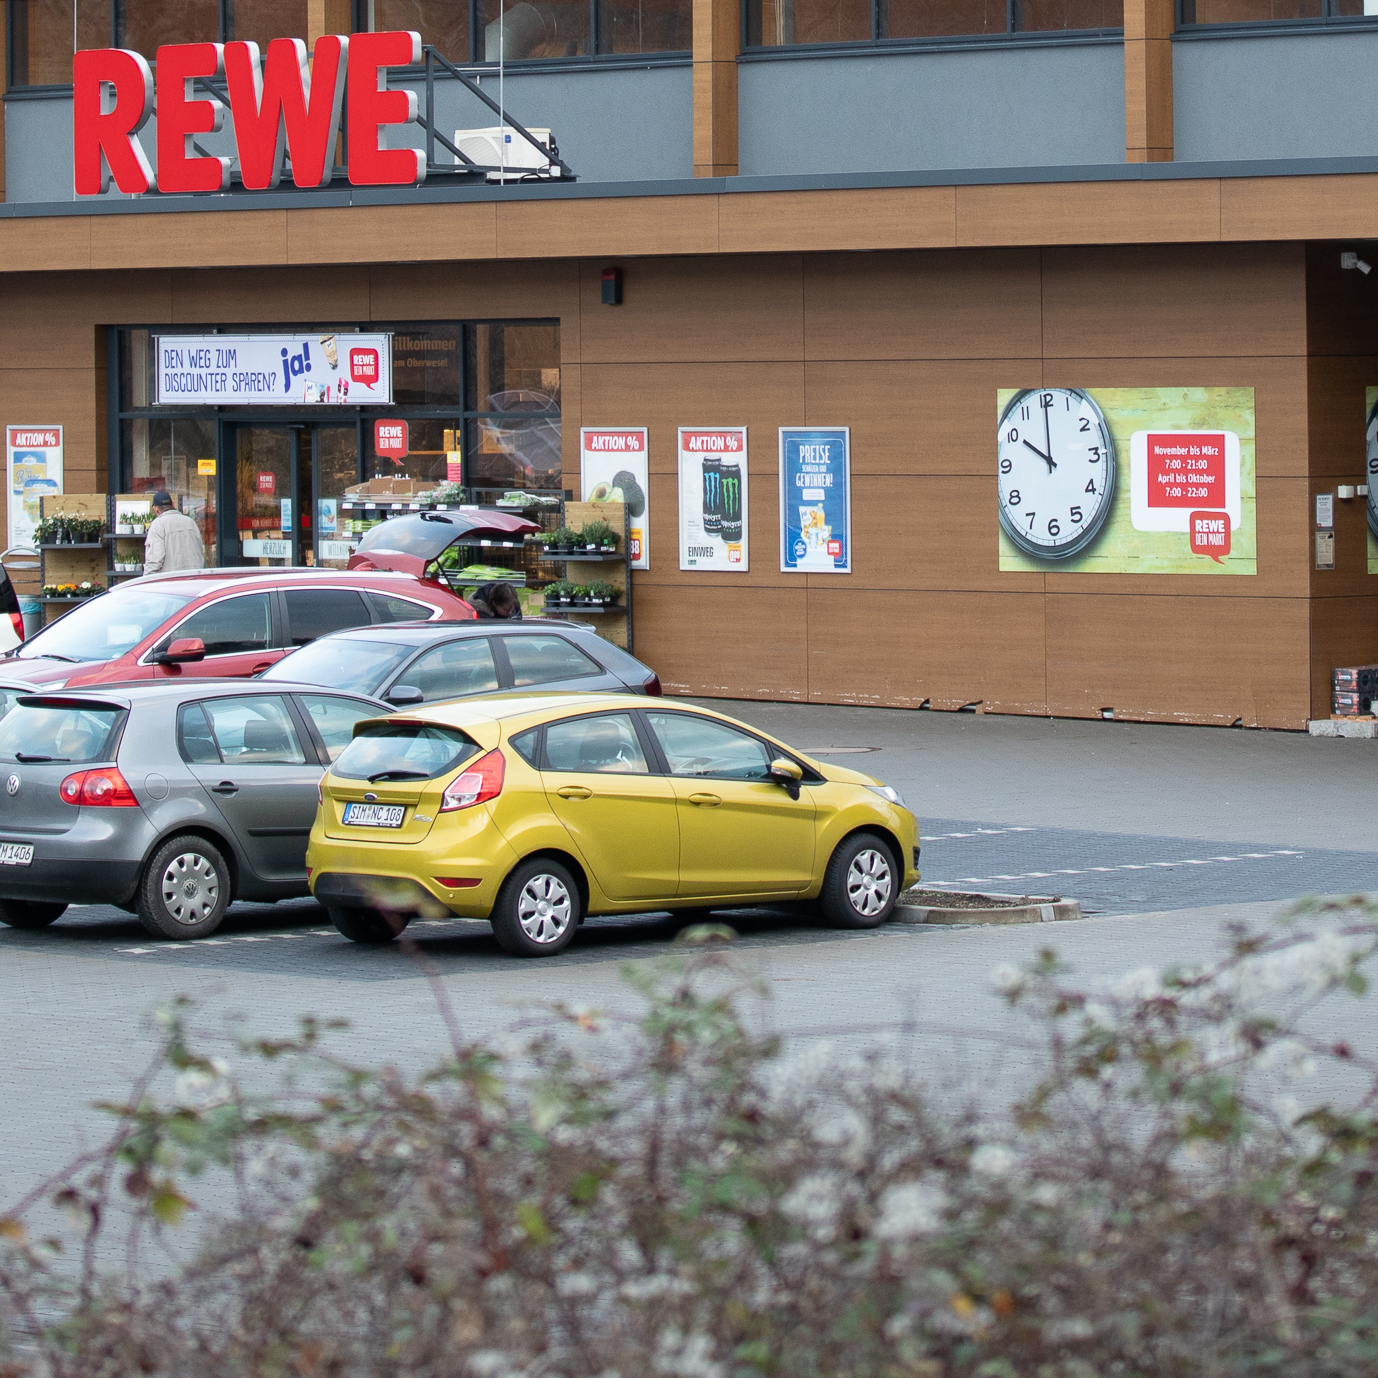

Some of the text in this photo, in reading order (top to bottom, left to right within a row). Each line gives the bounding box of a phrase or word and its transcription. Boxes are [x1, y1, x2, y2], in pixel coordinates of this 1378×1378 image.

[73, 31, 426, 196] REWE
[164, 349, 237, 369] DEN WEG ZUM
[353, 355, 375, 365] REWE
[281, 342, 312, 393] ja!
[165, 372, 276, 392] DISCOUNTER SPAREN?
[1021, 406, 1030, 420] 11
[1079, 417, 1090, 432] 2
[379, 427, 402, 437] REWE
[1007, 428, 1019, 443] 10
[16, 433, 56, 446] AKTION %
[380, 438, 402, 449] DEIN MARKT
[591, 436, 639, 450] AKTION %
[689, 436, 737, 450] AKTION %
[799, 445, 831, 464] PREISE
[1088, 447, 1101, 463] 3
[1154, 445, 1219, 456] November bis März
[1000, 459, 1012, 474] 9
[1165, 459, 1207, 469] 7:00 21:00
[796, 473, 833, 487] GEWINNEN!
[1157, 473, 1215, 485] April bis Oktober
[1085, 478, 1097, 495] 4
[1165, 487, 1208, 497] 7:00 22:00
[1008, 489, 1022, 506] 8
[1025, 512, 1036, 530] 7
[1070, 506, 1083, 523] 5
[1047, 518, 1061, 536] 6
[1195, 519, 1225, 532] REWE
[1195, 533, 1225, 546] DEIN MARKT
[262, 542, 286, 555] HERZLICH
[688, 546, 714, 558] EINWEG
[351, 805, 366, 819] SIM
[384, 807, 401, 822] 108
